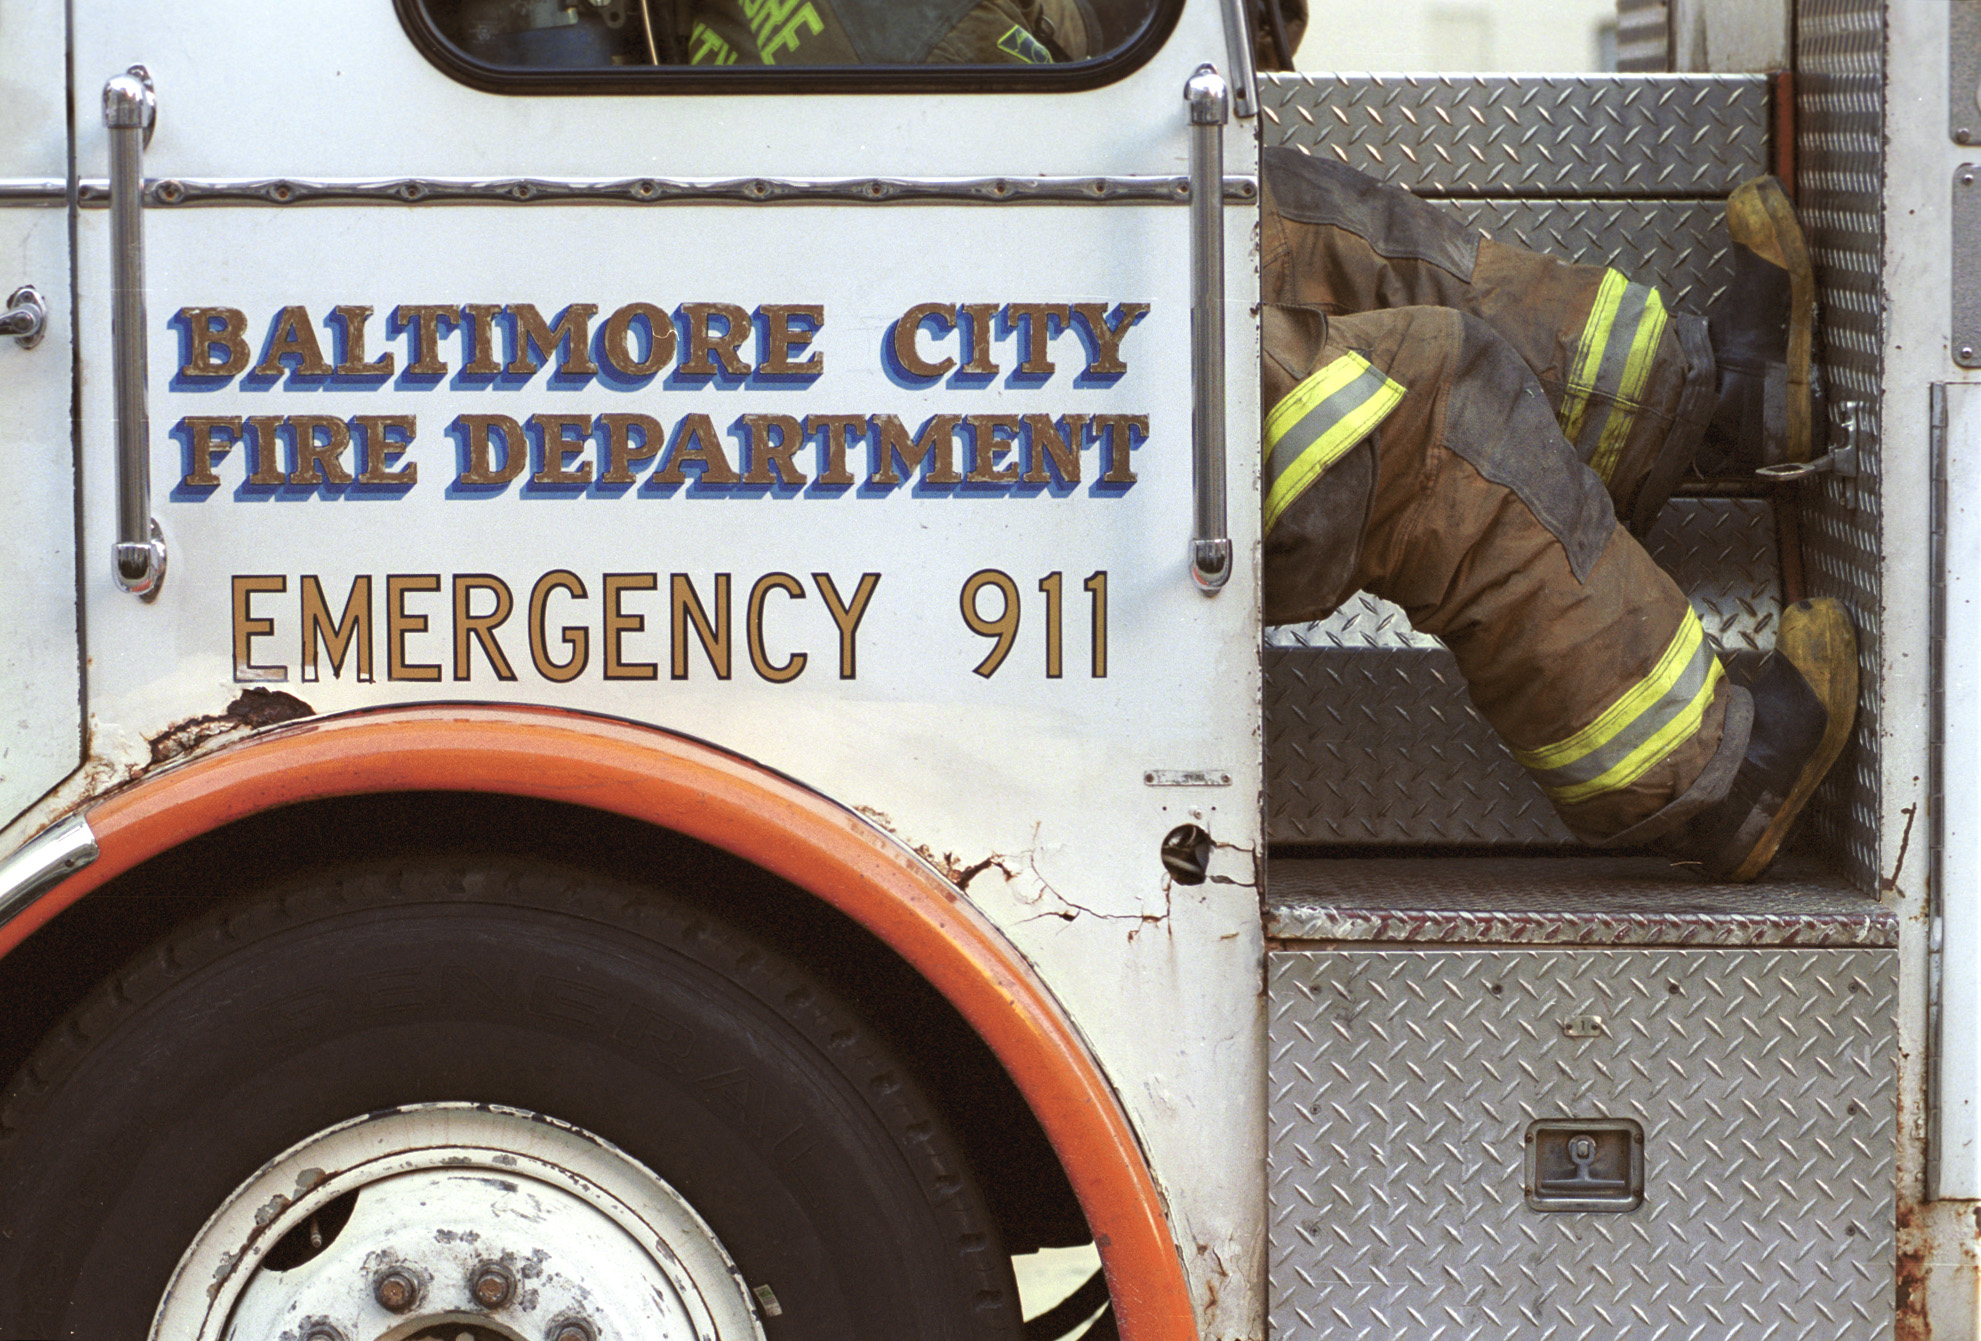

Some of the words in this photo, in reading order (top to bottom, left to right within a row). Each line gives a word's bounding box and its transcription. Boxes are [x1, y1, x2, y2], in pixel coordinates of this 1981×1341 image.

[167, 302, 824, 392] BALTIMORE
[880, 302, 1151, 390] CITY
[168, 414, 418, 502] FIRE
[444, 413, 1150, 500] DEPARTMENT
[231, 569, 882, 683] EMERGENCY
[959, 568, 1108, 681] 911
